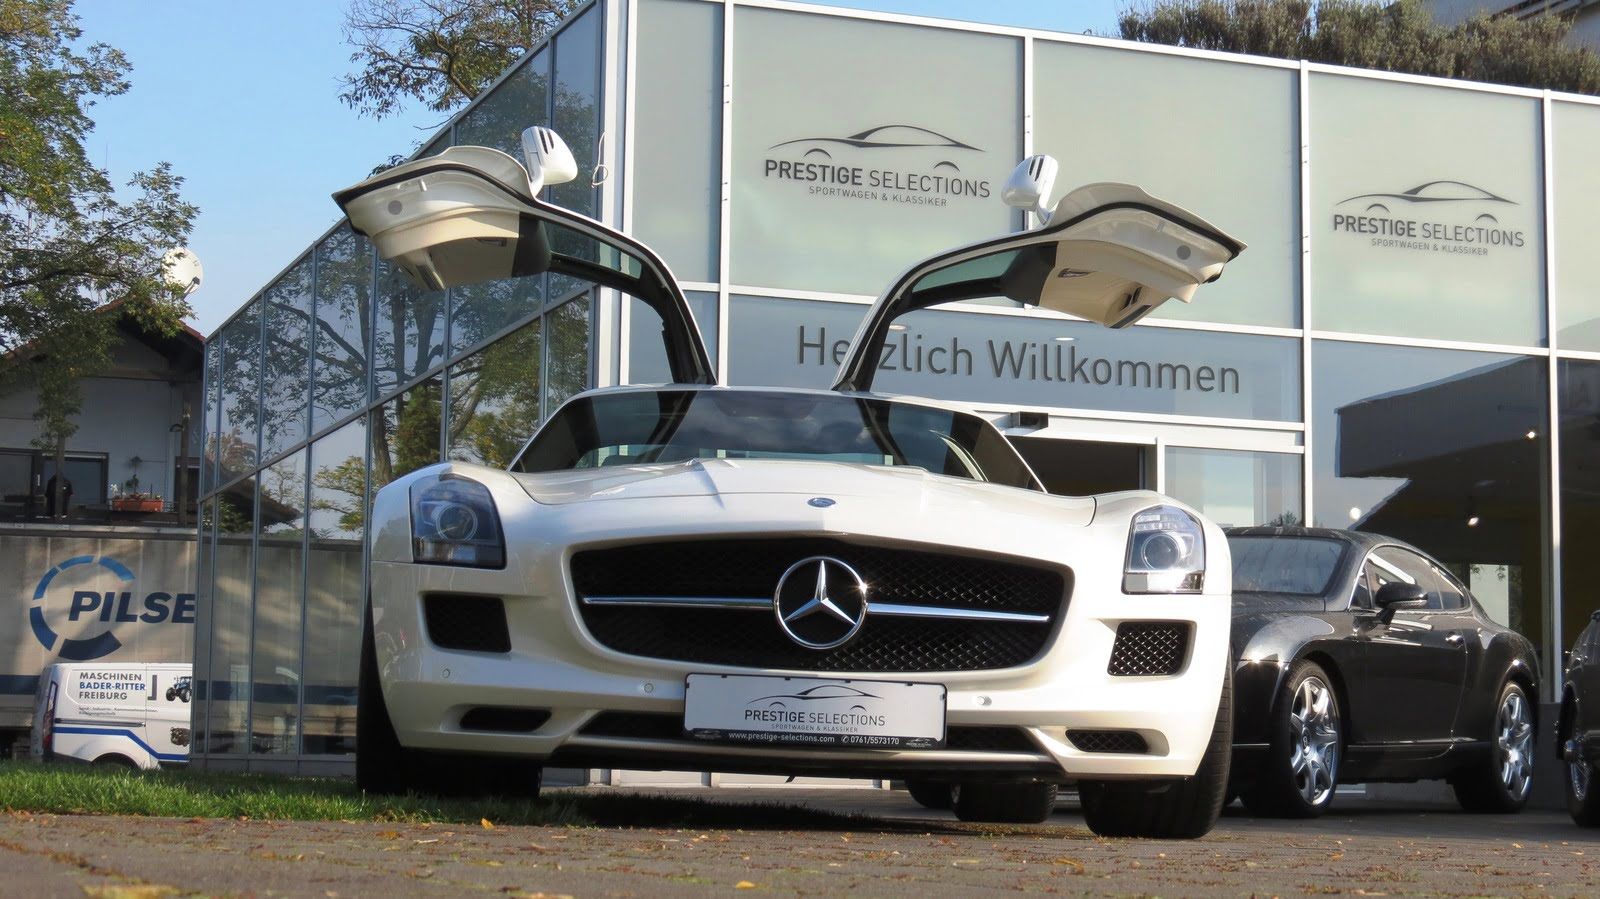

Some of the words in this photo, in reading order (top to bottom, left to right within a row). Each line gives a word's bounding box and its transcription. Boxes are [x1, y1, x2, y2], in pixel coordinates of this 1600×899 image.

[765, 159, 863, 186] PRESTIGE
[869, 170, 991, 198] SELECTIONS
[808, 186, 878, 200] SPORTWAGEN
[881, 193, 888, 201] &
[892, 195, 948, 207] KLASSIKER
[1333, 214, 1417, 238] PRESTIGE
[1422, 222, 1525, 248] SELECTIONS
[1371, 237, 1430, 251] SPORTWAGEN
[1442, 244, 1489, 256] KLASSIKER
[798, 325, 974, 376] Hezlich
[987, 339, 1241, 394] Willkommen
[79, 672, 142, 681] MASCHINEN
[79, 681, 146, 691] BADER-RITTER
[79, 691, 128, 700] FREIBURG
[744, 709, 805, 723] PRESTIGE
[809, 713, 886, 727] SELECTIONS
[771, 723, 815, 731] SPORTWAGEN
[728, 732, 835, 743] www.prestige-selections.com
